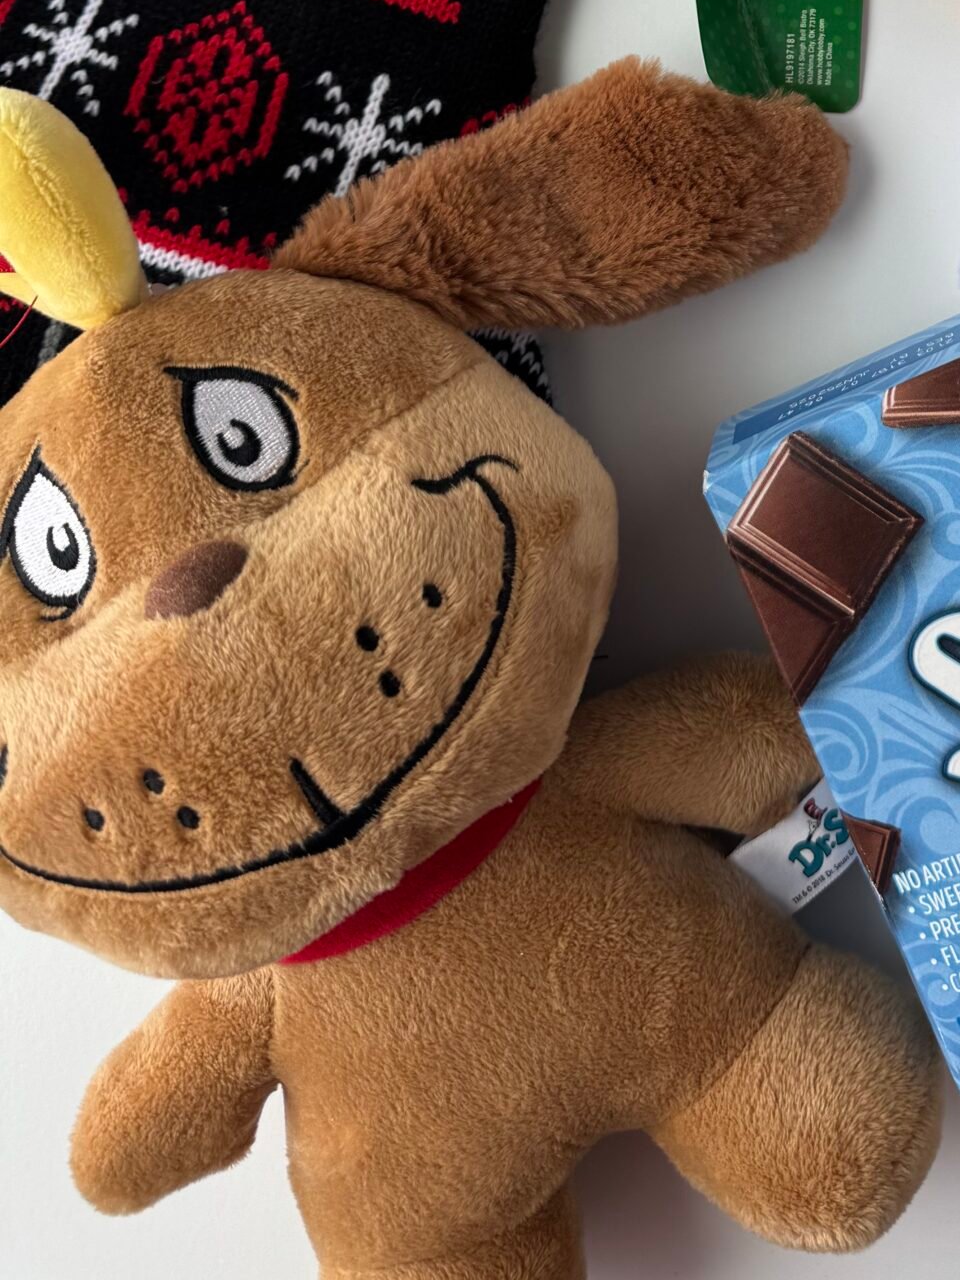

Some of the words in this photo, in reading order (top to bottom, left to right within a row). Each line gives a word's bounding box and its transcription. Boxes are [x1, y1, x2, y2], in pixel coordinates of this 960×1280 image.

[800, 9, 808, 28] Bistro
[809, 8, 817, 28] 73179
[785, 33, 796, 84] HL9197181
[799, 42, 807, 62] Sleigh
[817, 18, 825, 85] www.hobbylobby.com
[893, 868, 921, 894] NO
